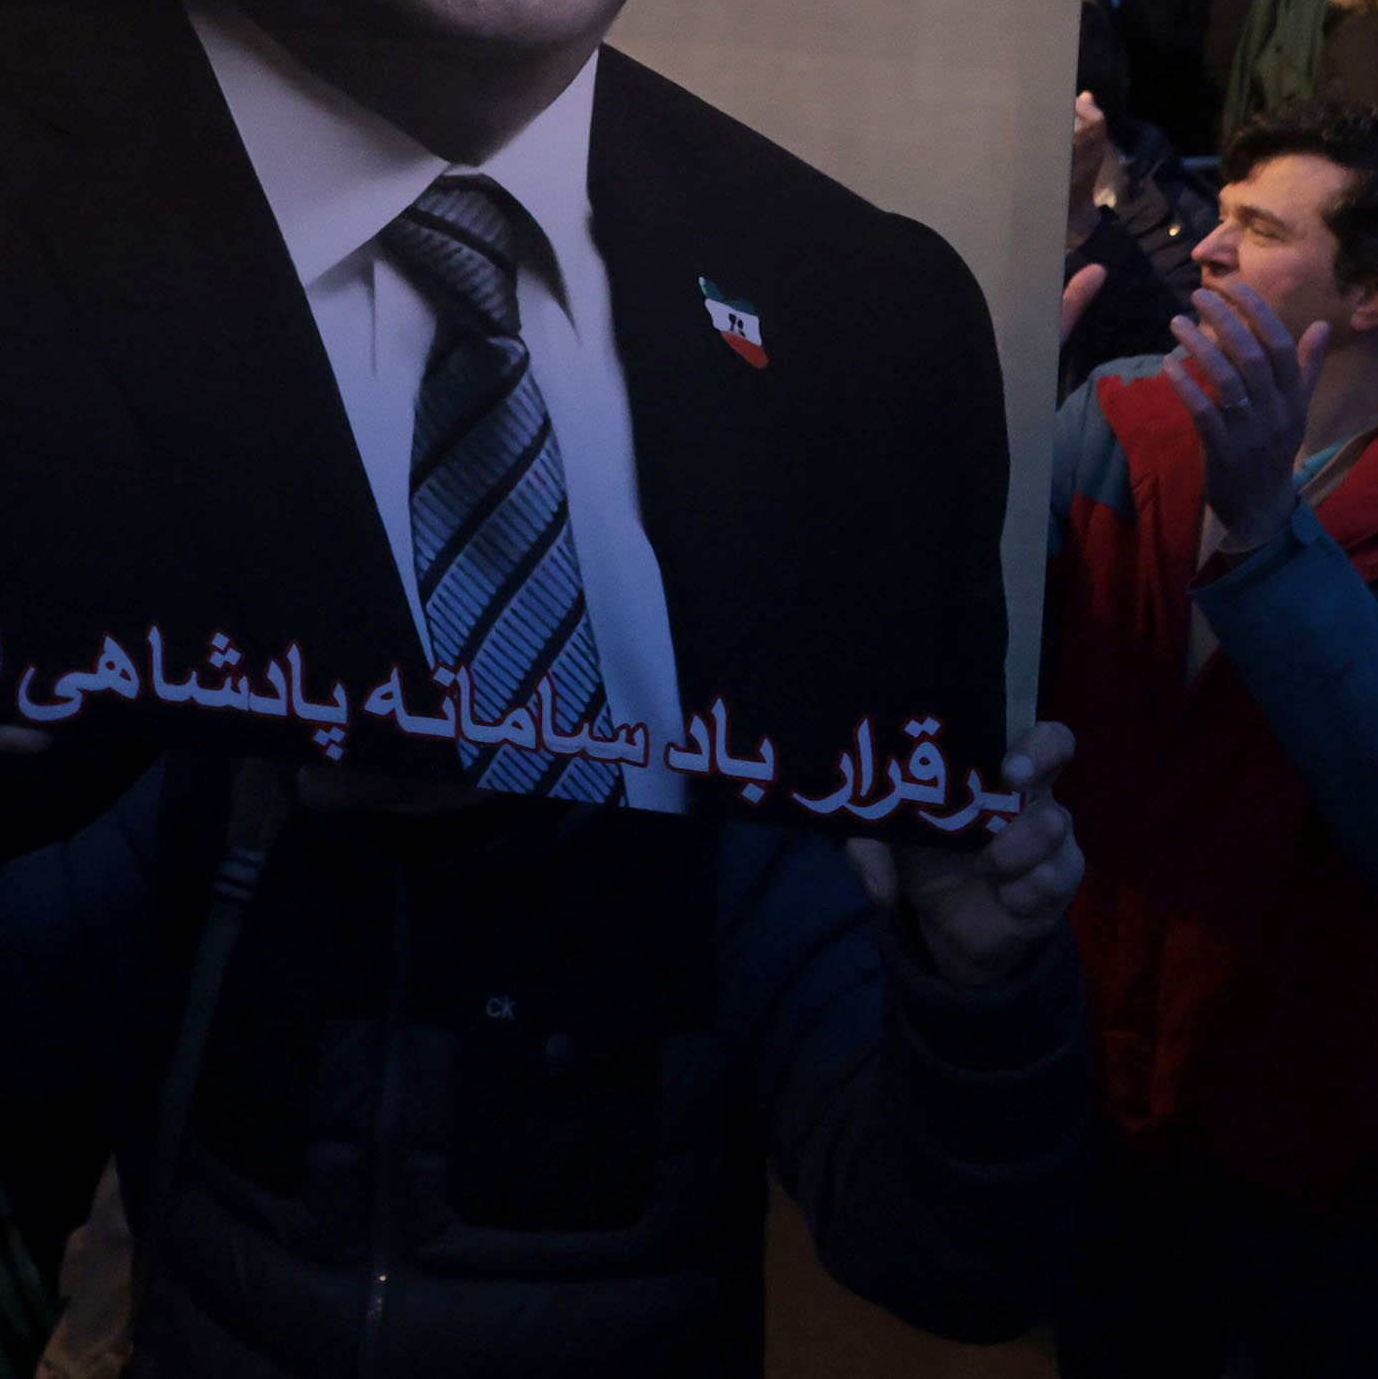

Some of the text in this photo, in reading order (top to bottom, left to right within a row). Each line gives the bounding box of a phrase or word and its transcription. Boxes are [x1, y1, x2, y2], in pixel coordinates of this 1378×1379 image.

[16, 623, 350, 762] پادشاهی
[362, 660, 650, 767] سامانه
[664, 695, 778, 804] باد
